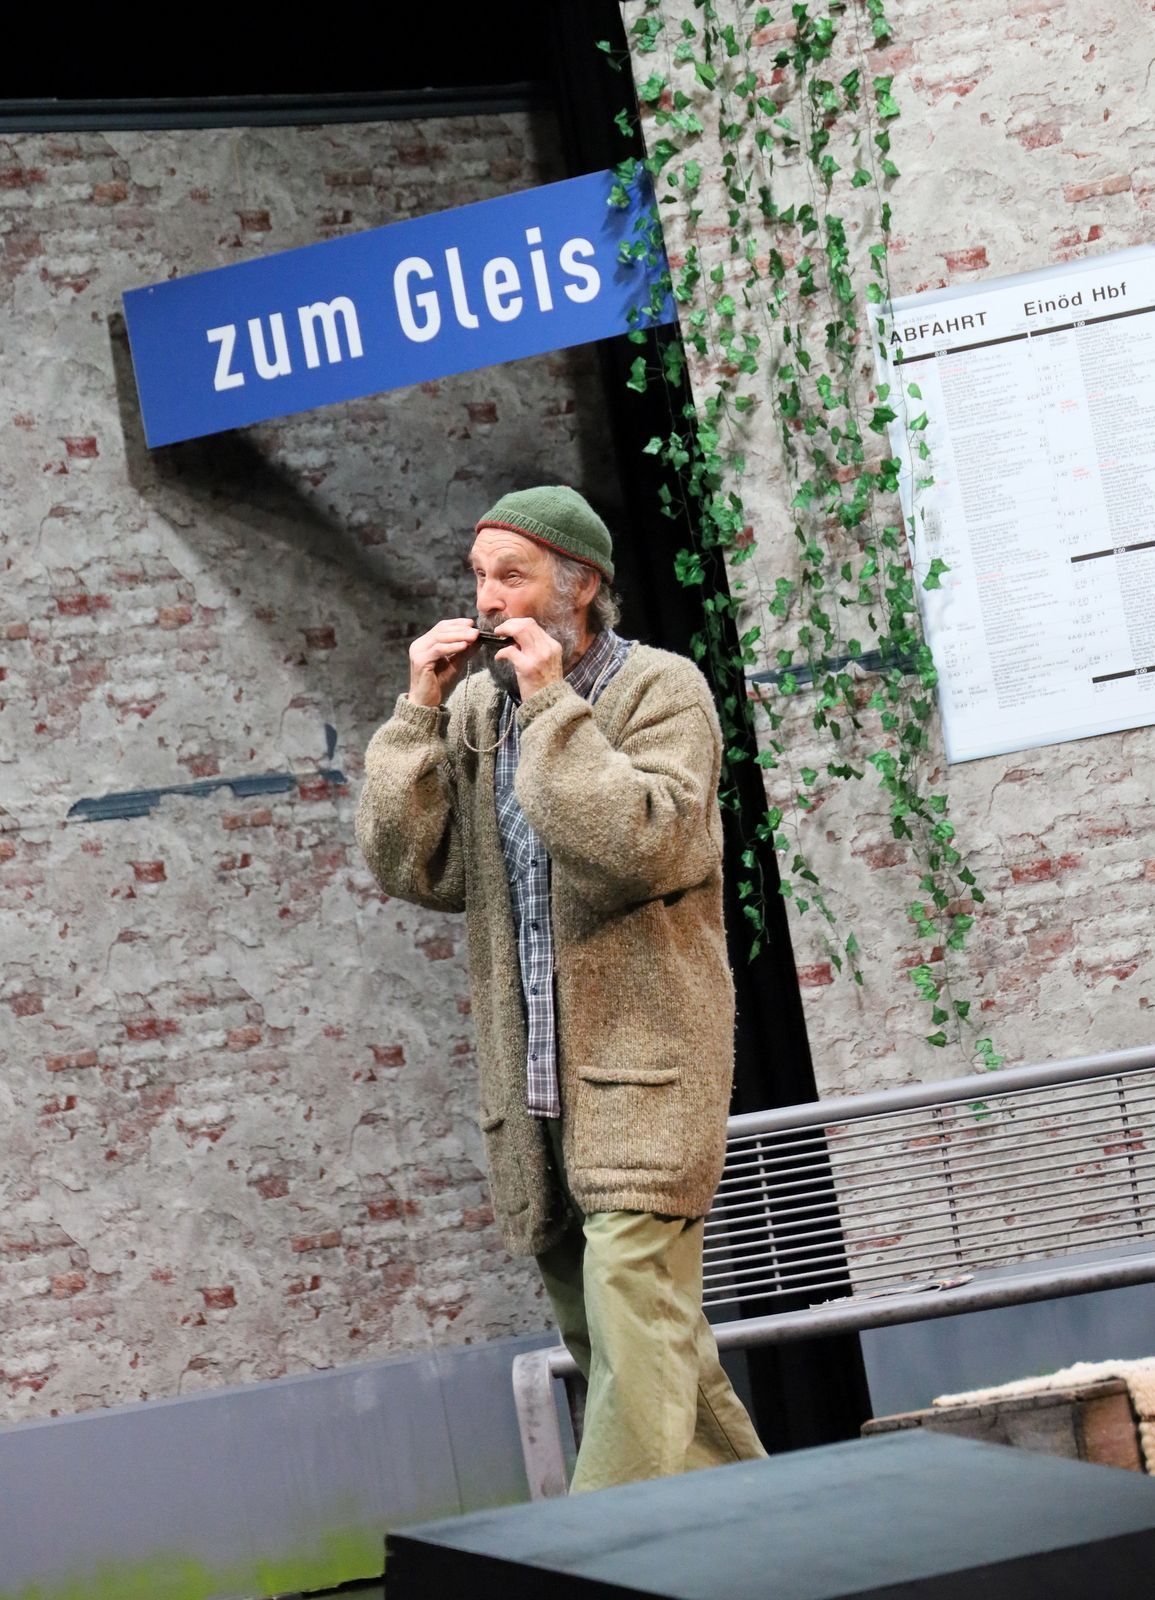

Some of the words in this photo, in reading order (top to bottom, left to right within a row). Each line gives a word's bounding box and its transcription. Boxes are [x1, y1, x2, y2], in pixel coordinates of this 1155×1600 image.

[206, 295, 364, 392] zum
[392, 226, 602, 343] Gleis
[1023, 292, 1083, 316] Einöd
[1092, 281, 1128, 303] Hbf
[890, 311, 988, 345] ABFAHRT
